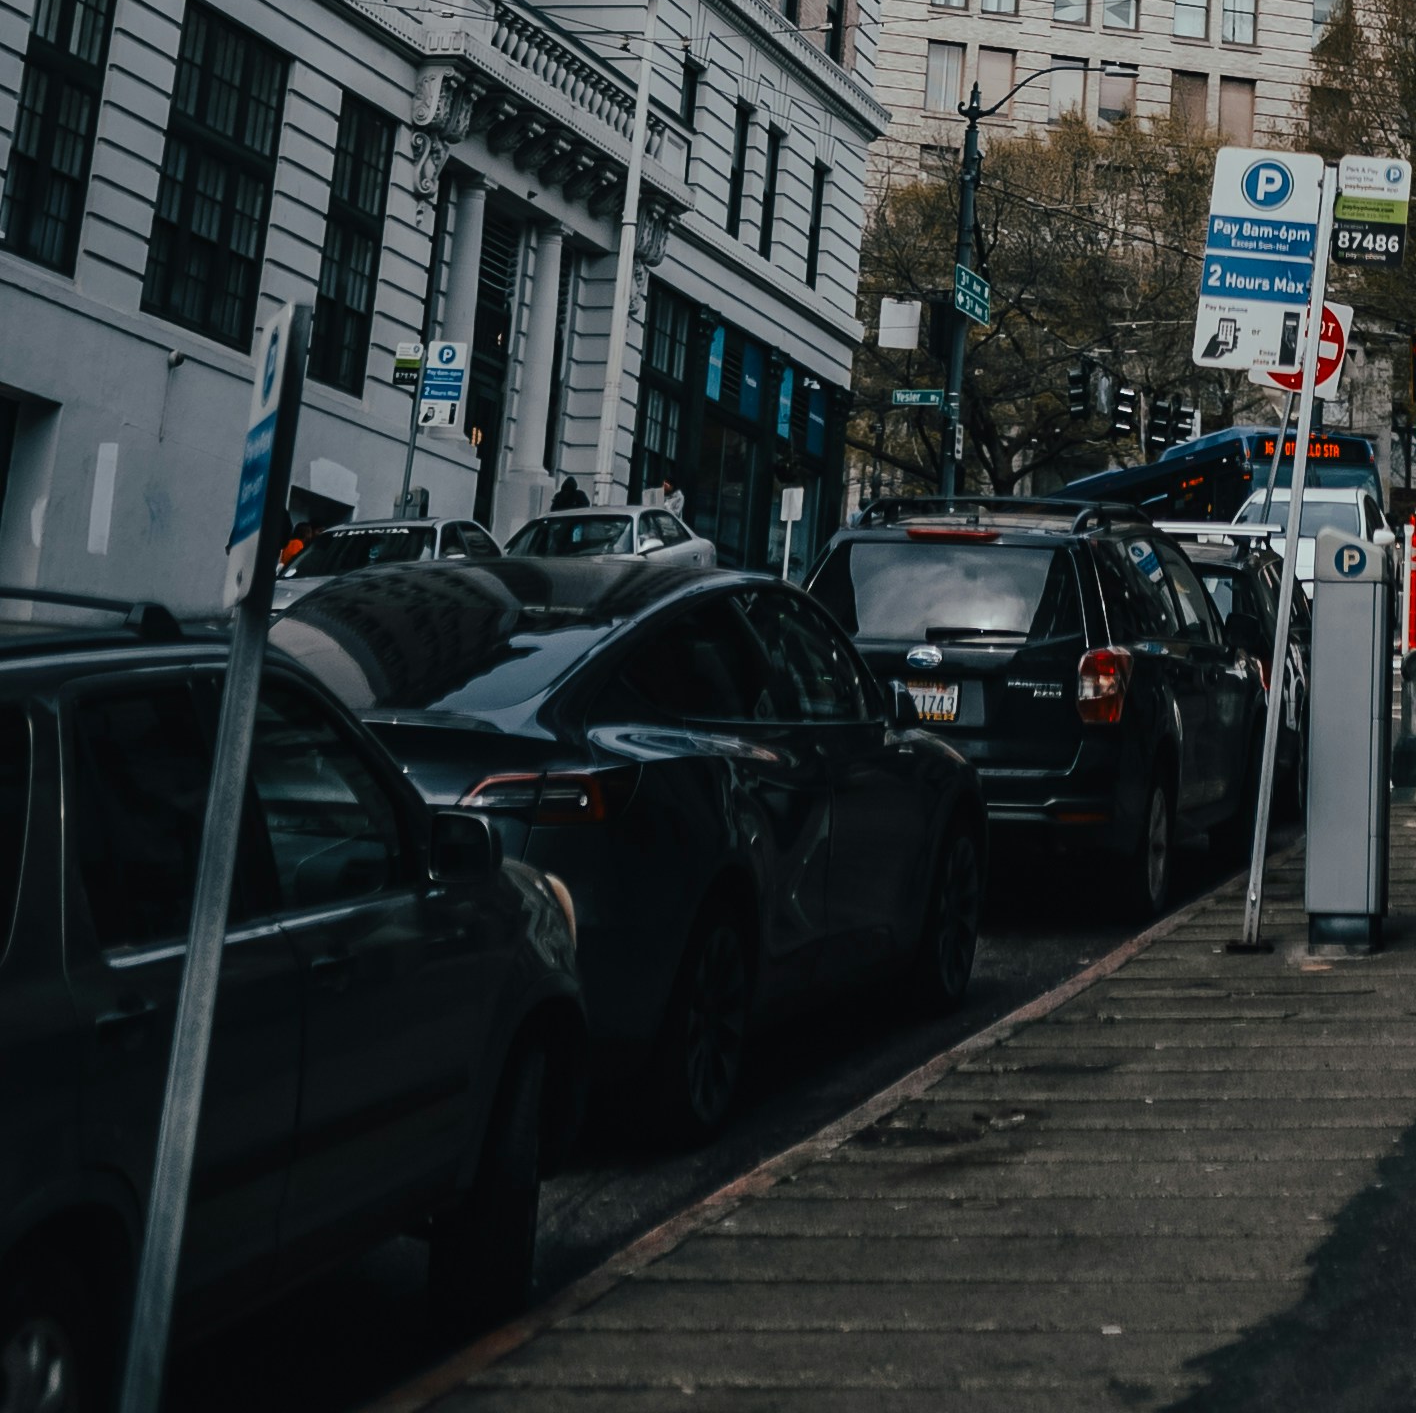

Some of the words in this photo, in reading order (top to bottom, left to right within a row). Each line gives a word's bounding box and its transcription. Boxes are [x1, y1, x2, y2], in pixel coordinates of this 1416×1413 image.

[1213, 218, 1240, 238] Pay
[1242, 221, 1311, 243] 8am-6pm
[1231, 238, 1257, 250] Except
[1337, 230, 1399, 253] 87486
[1207, 263, 1222, 287] 2
[1225, 271, 1270, 292] Hours
[1273, 276, 1305, 294] Max
[896, 392, 921, 403] Yesler
[1323, 443, 1340, 458] STA
